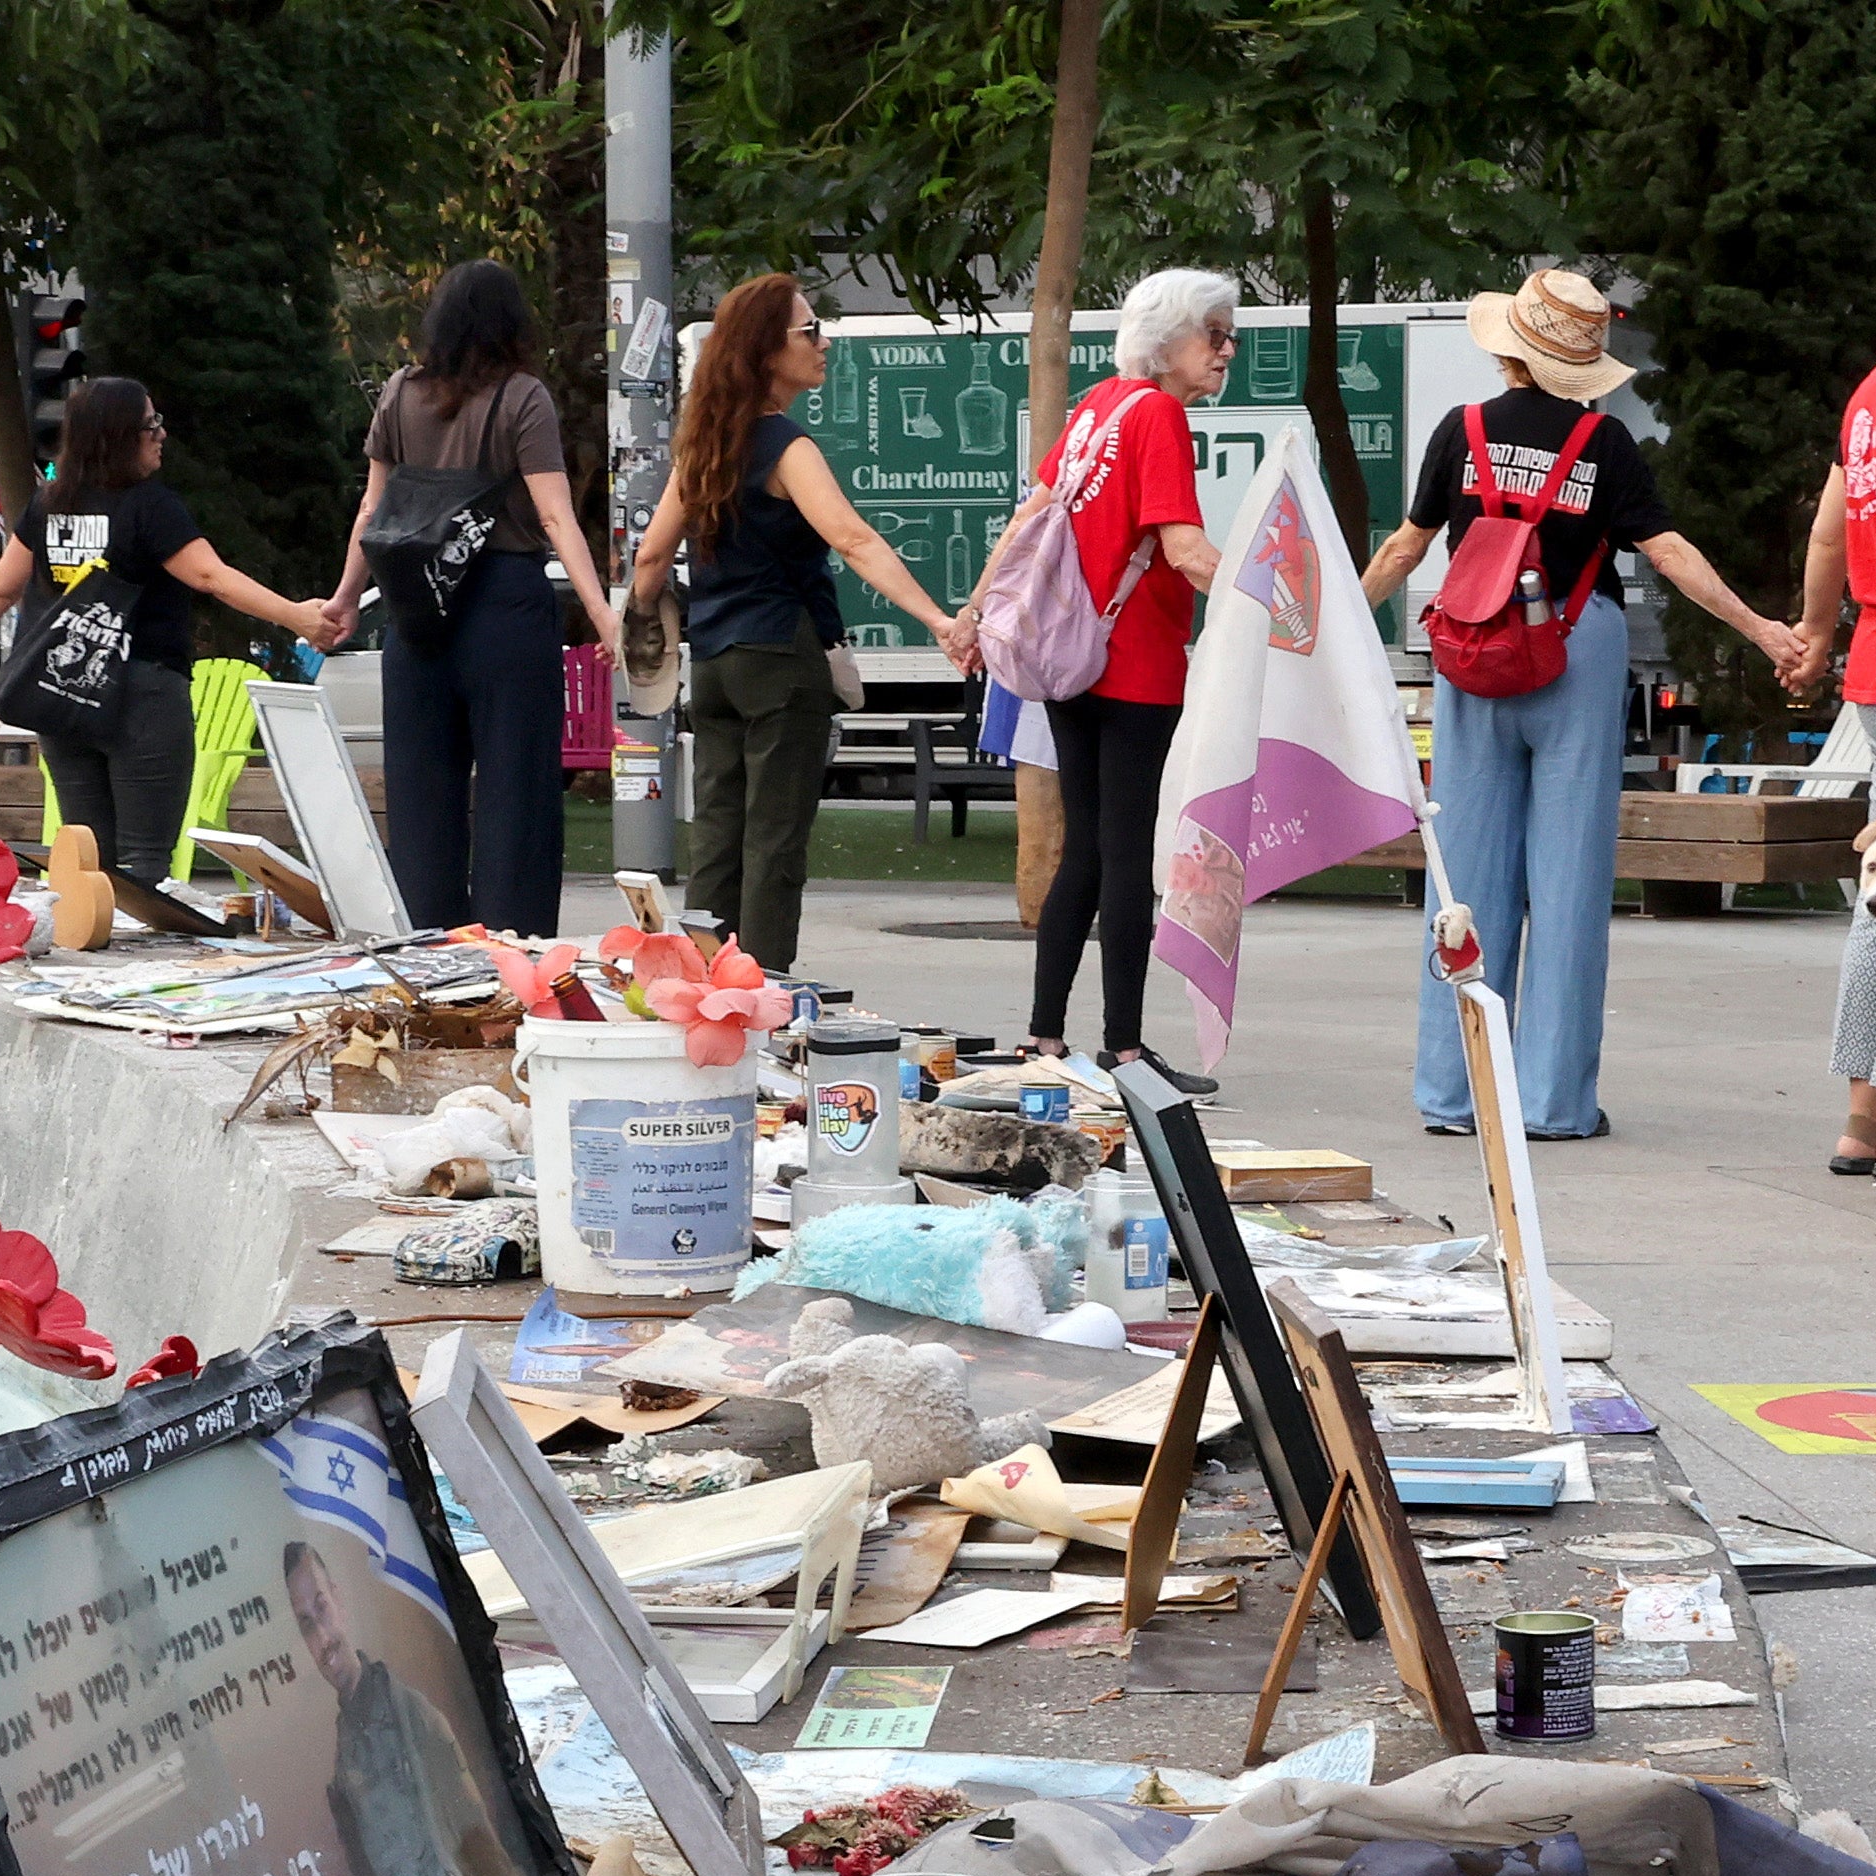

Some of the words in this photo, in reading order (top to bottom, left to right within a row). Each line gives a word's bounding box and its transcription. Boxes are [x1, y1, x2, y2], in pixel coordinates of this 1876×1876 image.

[870, 345, 946, 365] VODKA
[851, 463, 1012, 495] Chardonnay
[818, 1086, 846, 1104] live
[819, 1104, 850, 1120] like
[629, 1122, 683, 1138] SUPER
[686, 1119, 731, 1136] SILVER
[632, 1161, 658, 1175] כללי
[659, 1161, 692, 1177] לניקוי
[631, 1202, 668, 1216] General
[669, 1200, 707, 1216] Cleaning
[227, 1595, 271, 1637] חיים
[24, 1613, 72, 1662] יוכלו
[79, 1662, 131, 1723] קומץ
[248, 1652, 298, 1708] צריך
[34, 1690, 74, 1731] של
[188, 1671, 244, 1731] לחיות
[107, 1727, 138, 1774] לא
[141, 1710, 186, 1754] חיים
[195, 1794, 266, 1866] לזכרו
